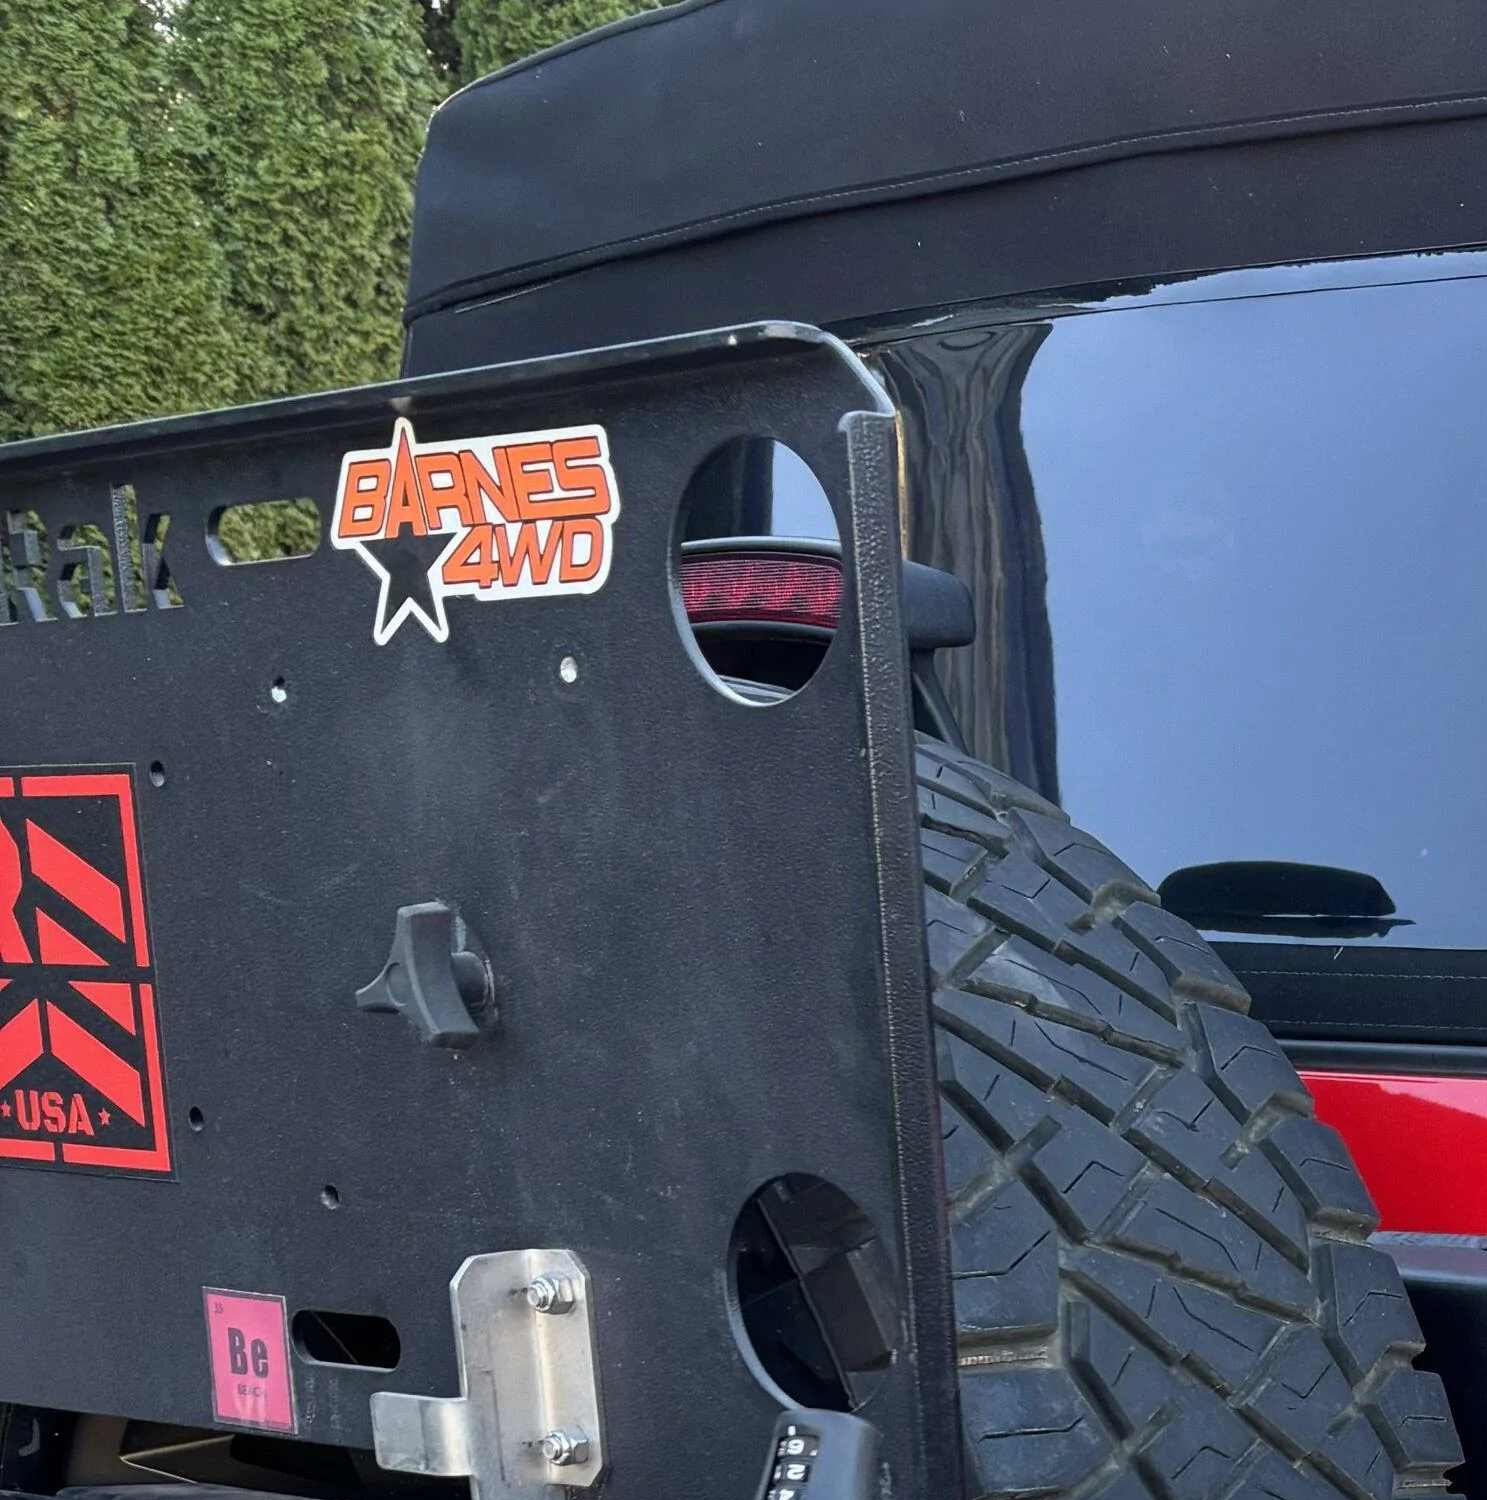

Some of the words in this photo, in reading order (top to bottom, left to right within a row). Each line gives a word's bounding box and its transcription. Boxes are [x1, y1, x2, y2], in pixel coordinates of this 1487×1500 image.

[338, 428, 612, 539] BARNES
[441, 513, 605, 588] 4WD
[14, 1089, 95, 1137] USA
[228, 1327, 269, 1379] Be
